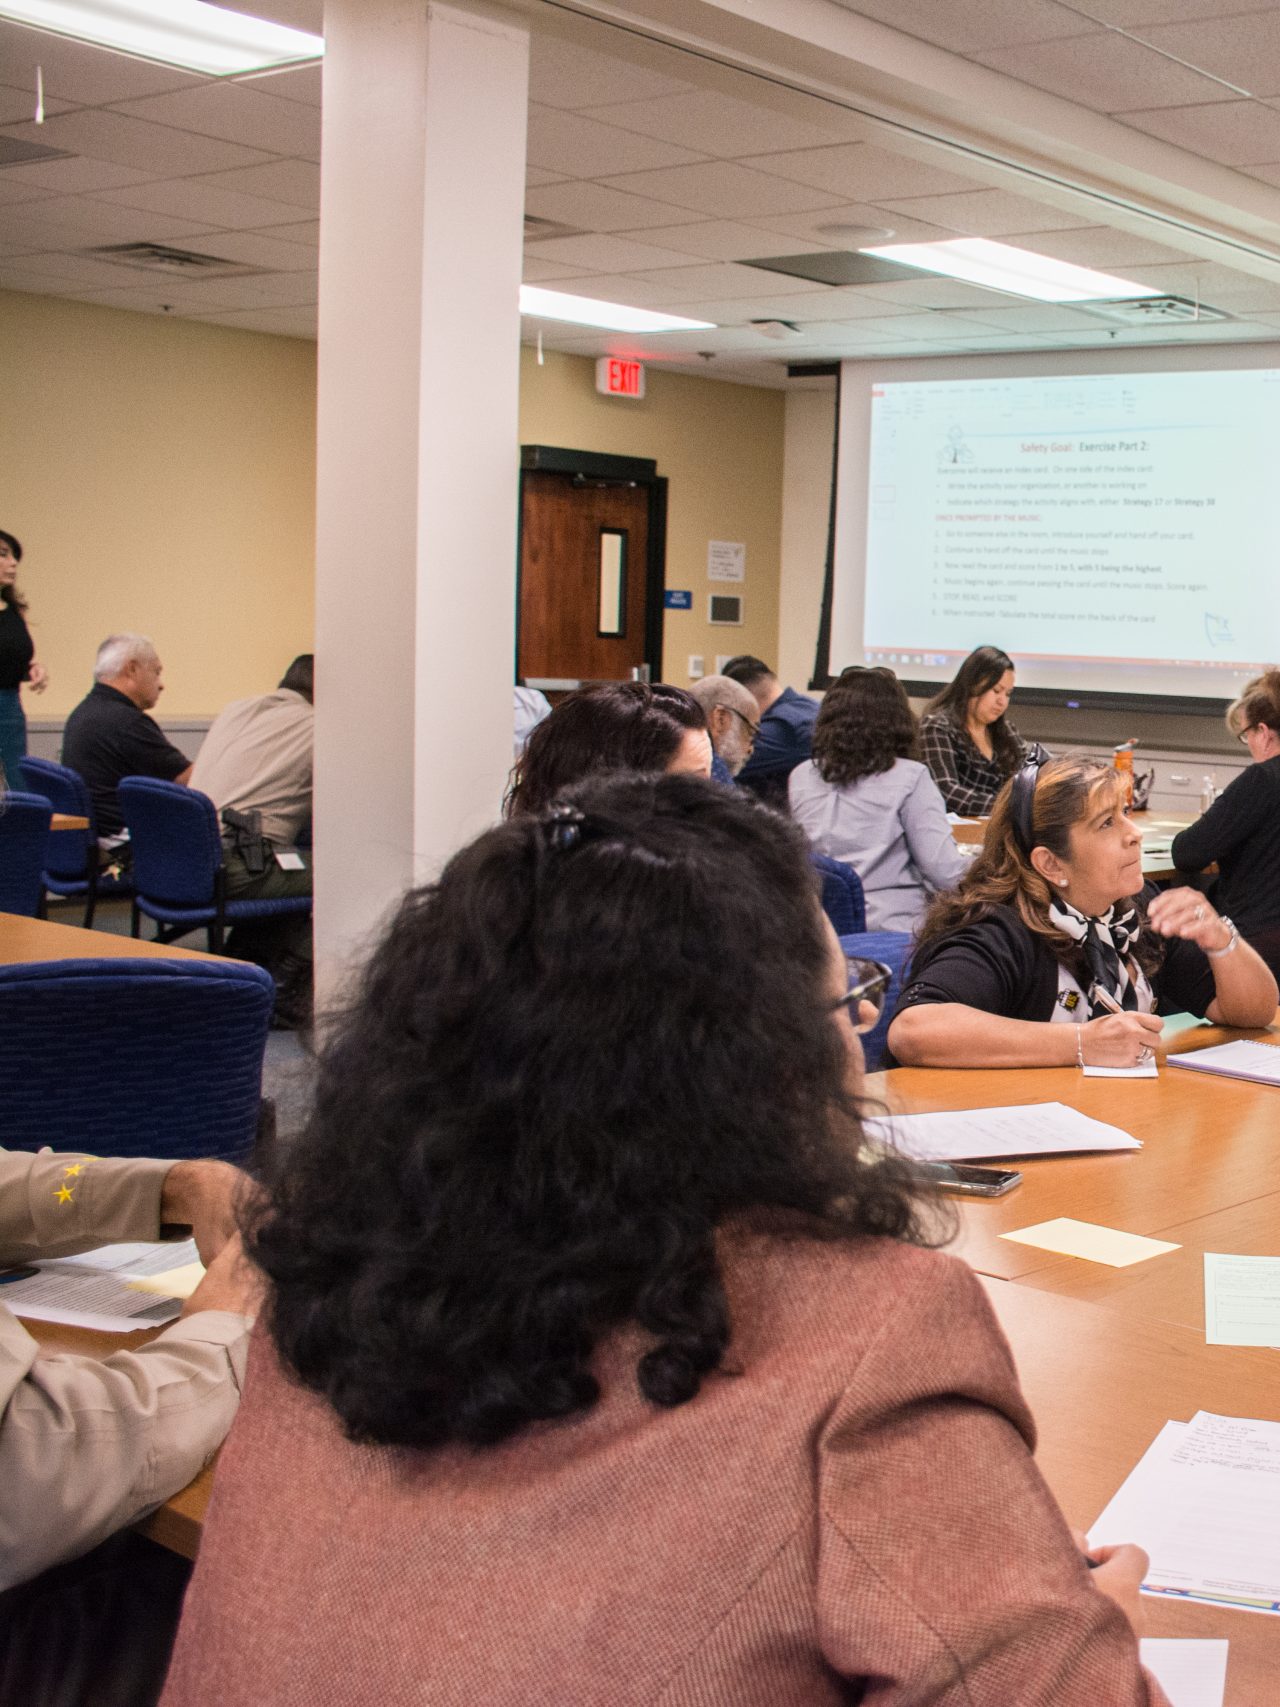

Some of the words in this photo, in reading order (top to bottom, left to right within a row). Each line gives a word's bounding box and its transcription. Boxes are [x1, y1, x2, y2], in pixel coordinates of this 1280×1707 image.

[609, 359, 640, 395] EXIT
[1020, 442, 1048, 455] Safety
[1050, 441, 1075, 452] Goal:
[1079, 441, 1116, 452] Exercise
[1118, 441, 1138, 451] Part
[1140, 441, 1150, 451] 2:
